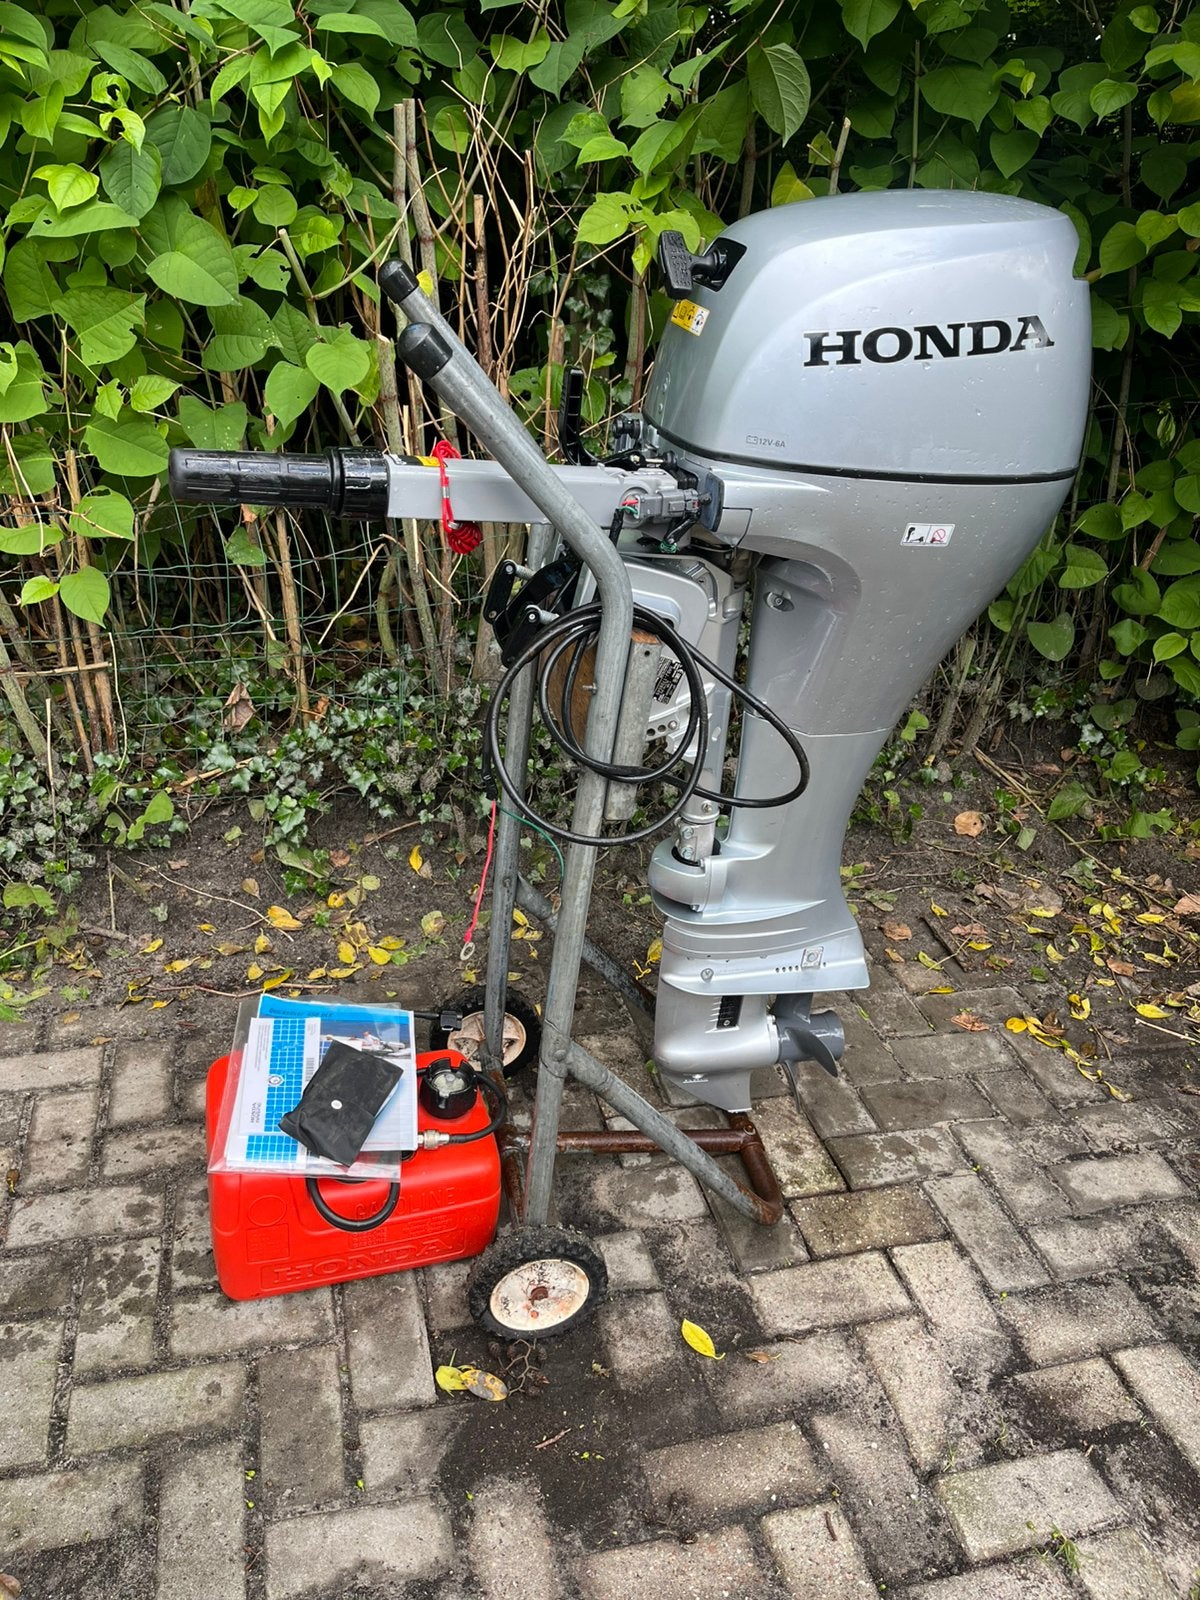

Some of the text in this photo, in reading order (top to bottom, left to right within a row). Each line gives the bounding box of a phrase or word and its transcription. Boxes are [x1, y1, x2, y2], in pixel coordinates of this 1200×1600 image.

[803, 315, 1055, 367] HONDA
[759, 438, 786, 448] 12V-6A
[355, 1186, 456, 1221] GAOLINE
[273, 1238, 453, 1284] HONDA
